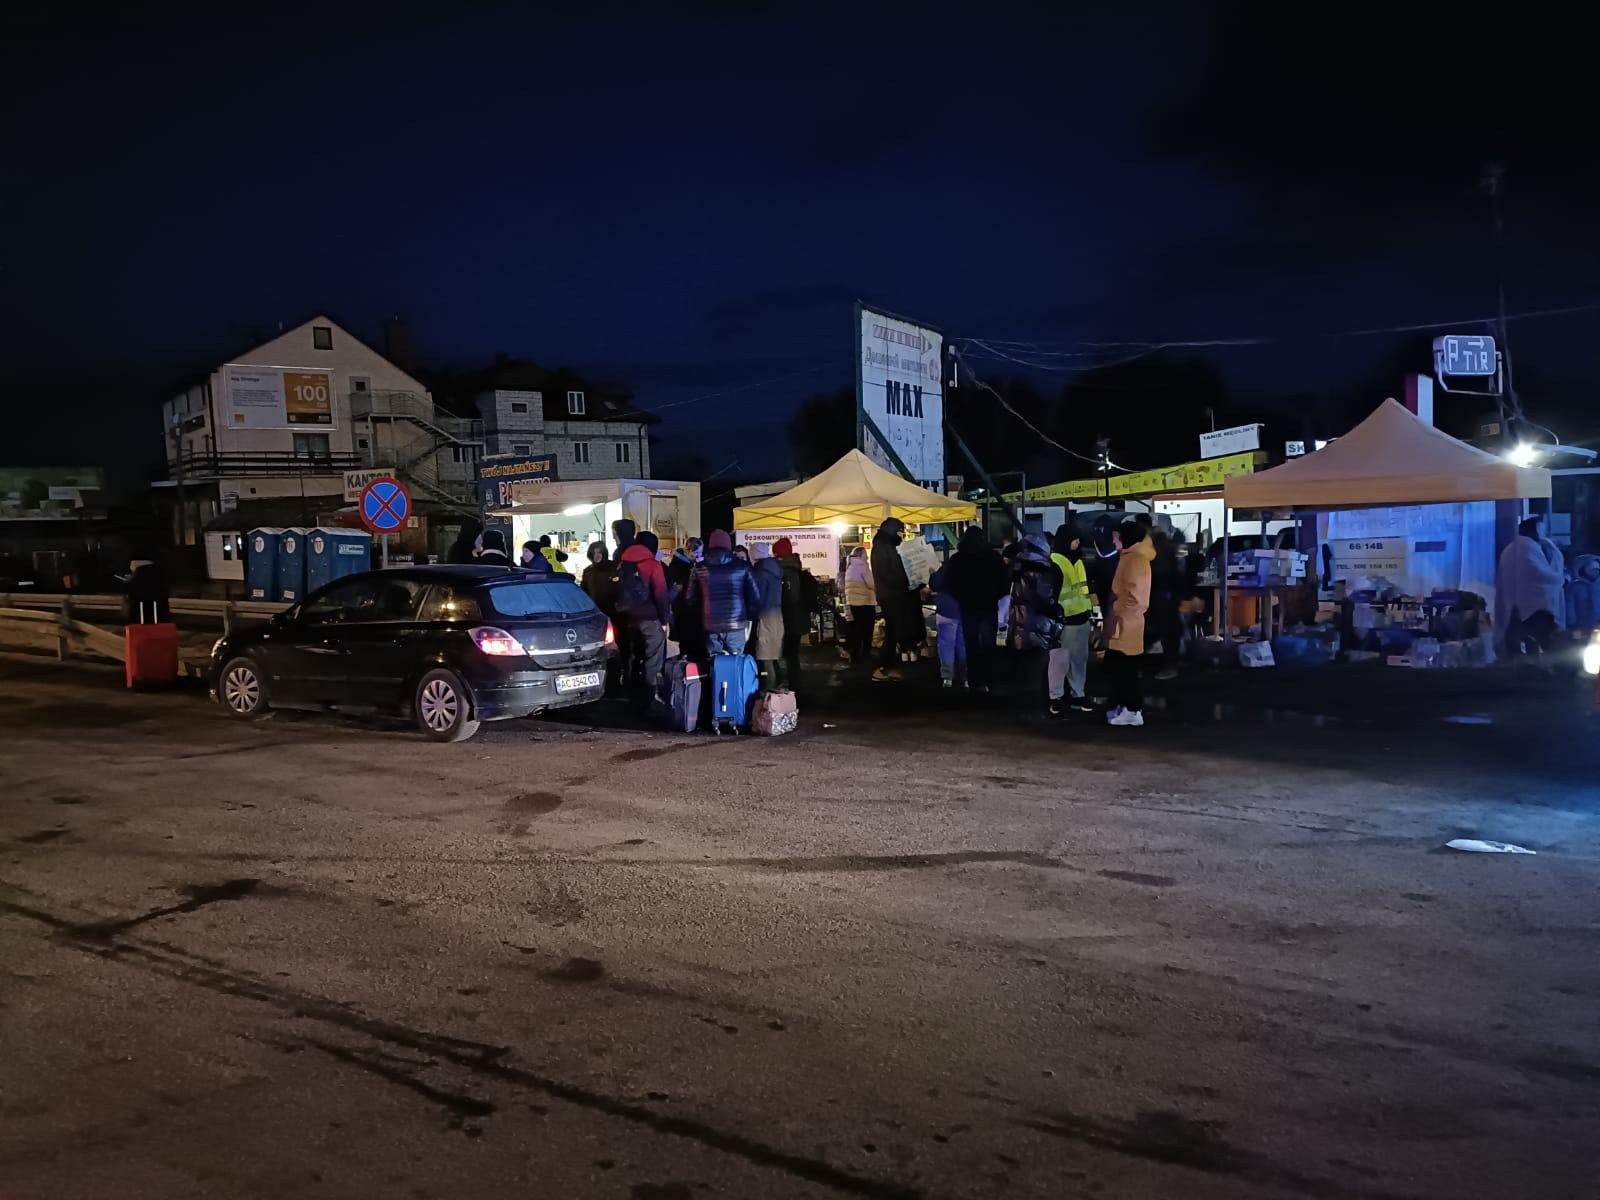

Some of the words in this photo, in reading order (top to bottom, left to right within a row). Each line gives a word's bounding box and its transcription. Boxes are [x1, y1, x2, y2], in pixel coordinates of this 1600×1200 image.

[1463, 350, 1489, 372] TIR
[293, 385, 327, 401] 100
[886, 379, 924, 418] MAX
[480, 464, 503, 478] TWÓJ
